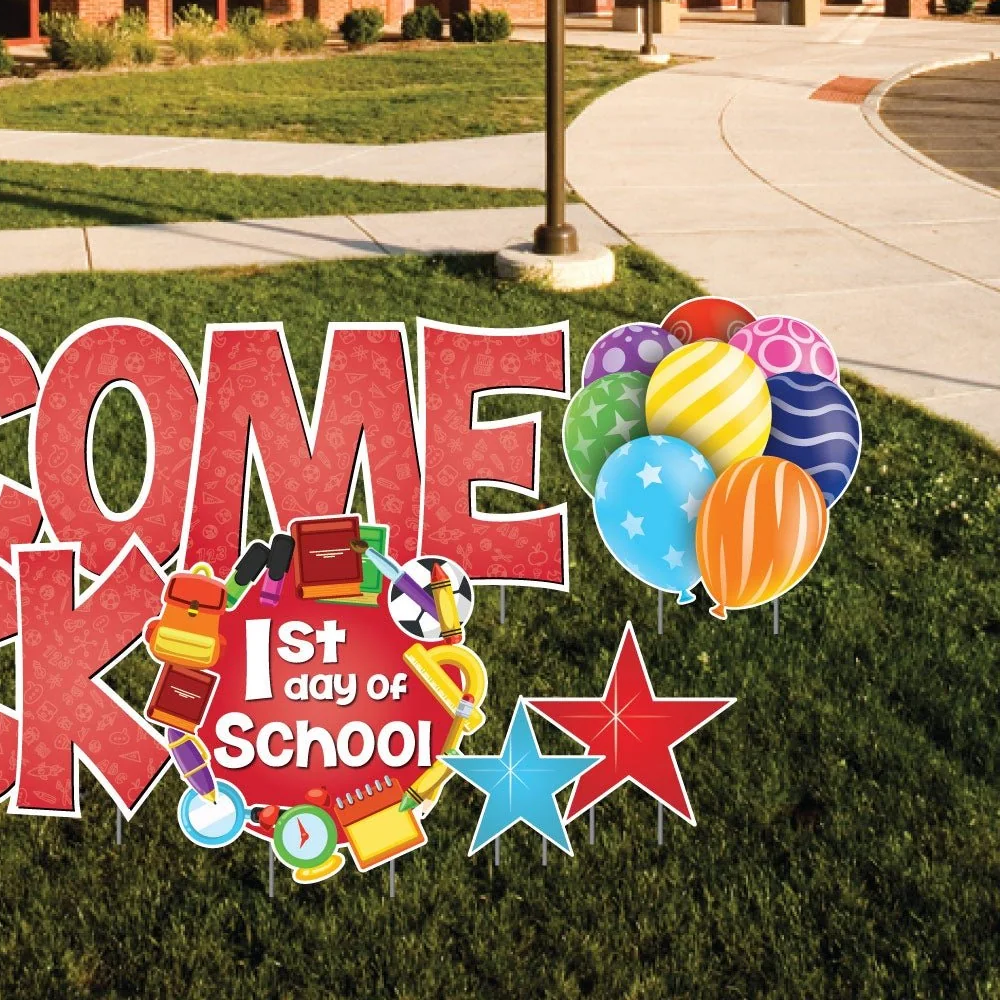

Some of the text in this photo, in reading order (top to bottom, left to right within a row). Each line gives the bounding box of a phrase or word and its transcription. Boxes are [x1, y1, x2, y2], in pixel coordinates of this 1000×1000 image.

[284, 672, 408, 706] day of
[213, 711, 432, 769] School
